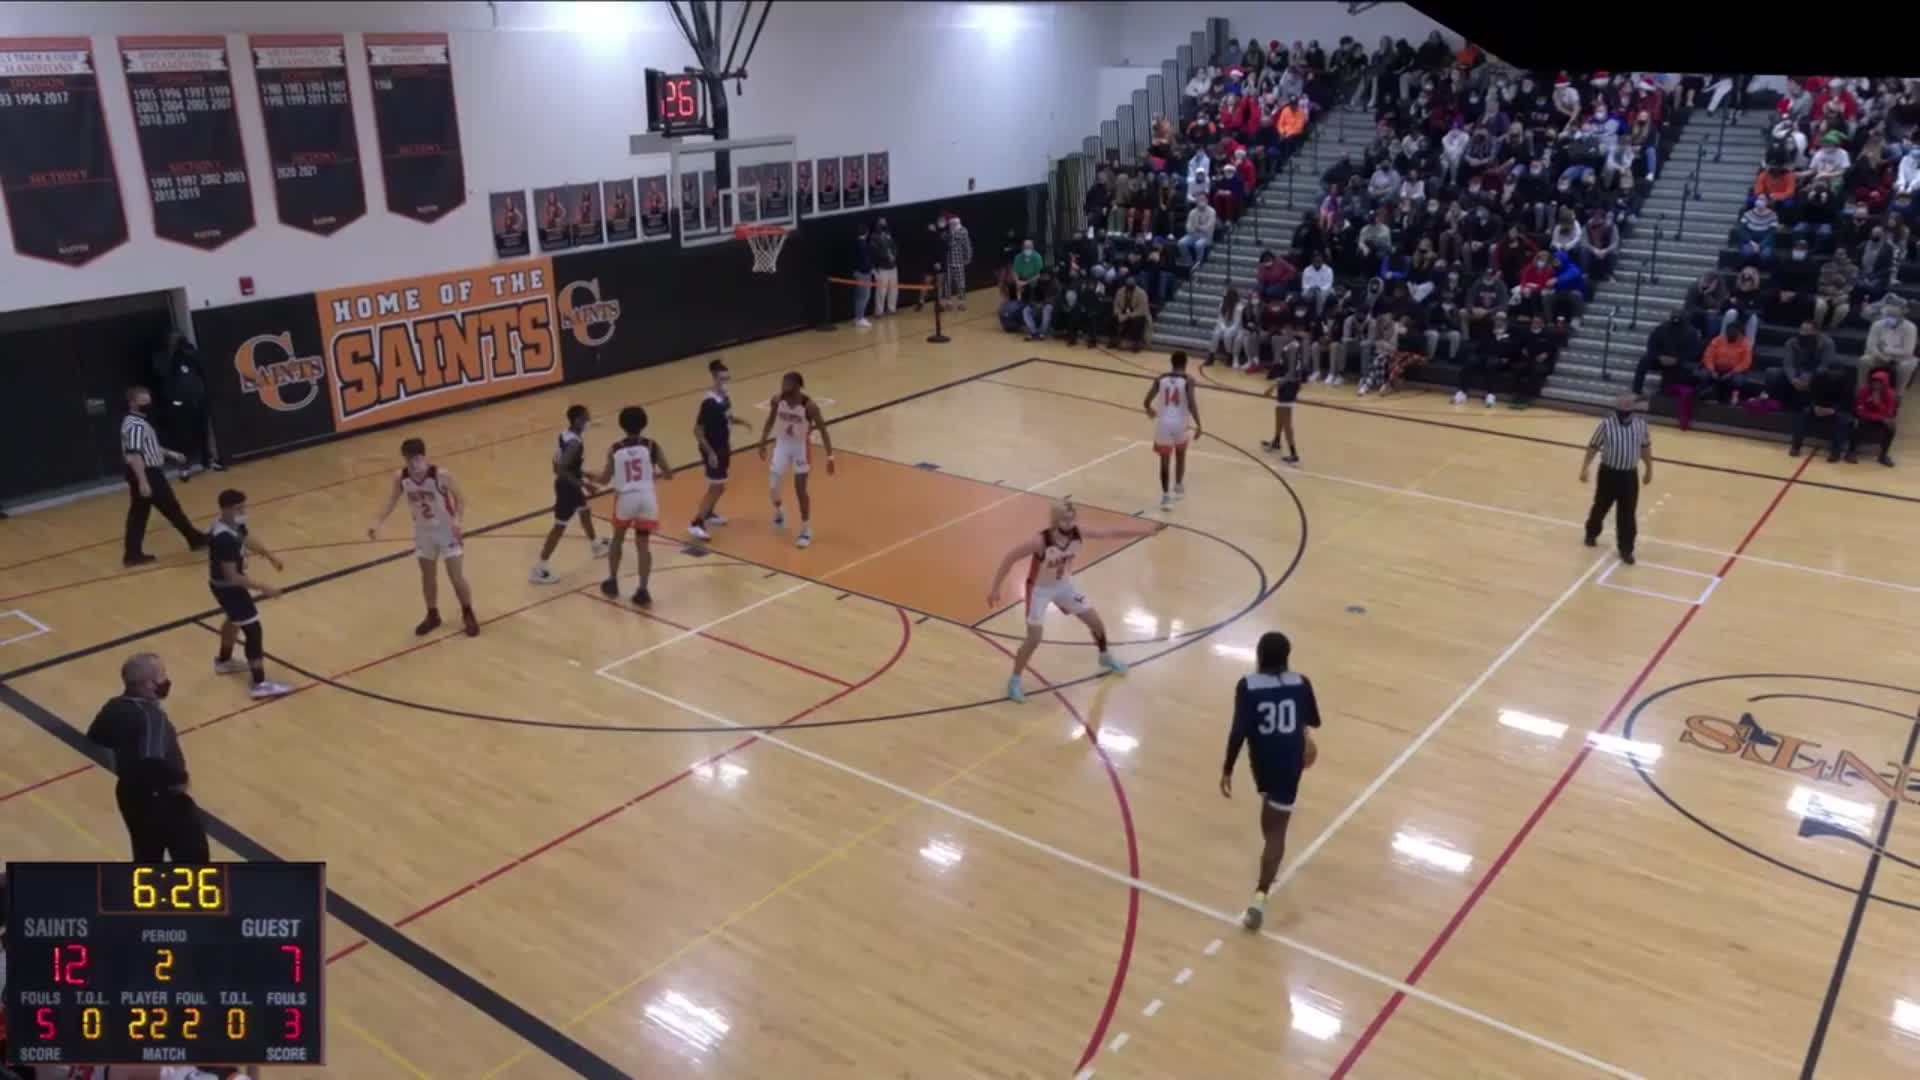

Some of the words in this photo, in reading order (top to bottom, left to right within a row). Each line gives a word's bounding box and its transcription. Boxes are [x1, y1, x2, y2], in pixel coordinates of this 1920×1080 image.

[43, 91, 69, 105] 2017
[660, 79, 695, 118] 26
[332, 287, 421, 324] HOME
[440, 279, 473, 305] OF
[490, 267, 545, 296] THE
[334, 298, 555, 418] SAINTS
[1163, 386, 1181, 407] 14
[624, 458, 643, 483] 15
[1257, 699, 1297, 735] 30
